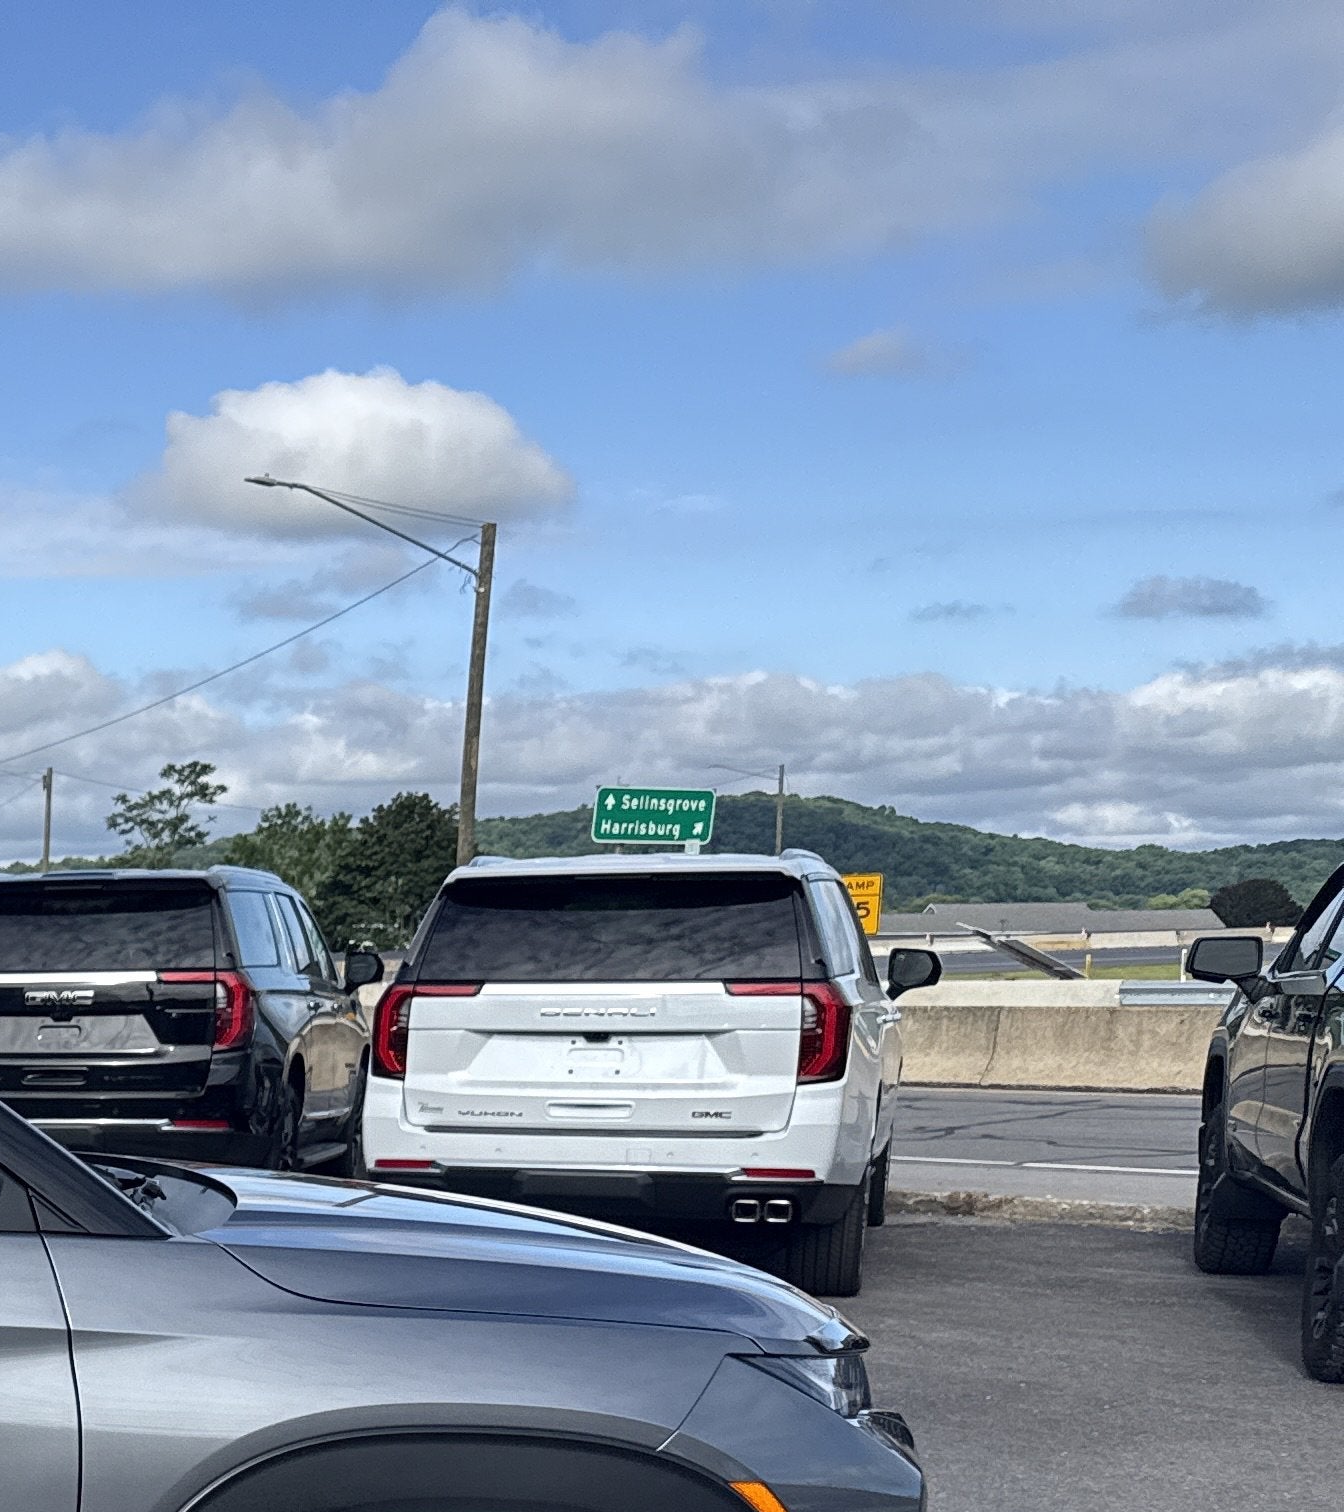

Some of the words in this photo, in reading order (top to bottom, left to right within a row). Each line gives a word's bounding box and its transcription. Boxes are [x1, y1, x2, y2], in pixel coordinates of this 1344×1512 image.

[621, 794, 706, 815] Selinsgrove
[600, 819, 680, 840] Harrisburg
[847, 880, 875, 890] AMP
[856, 901, 871, 918] 5
[24, 990, 95, 1006] GMC
[540, 1007, 657, 1018] DENALI
[457, 1110, 524, 1118] YUKON
[691, 1111, 732, 1120] GMC
